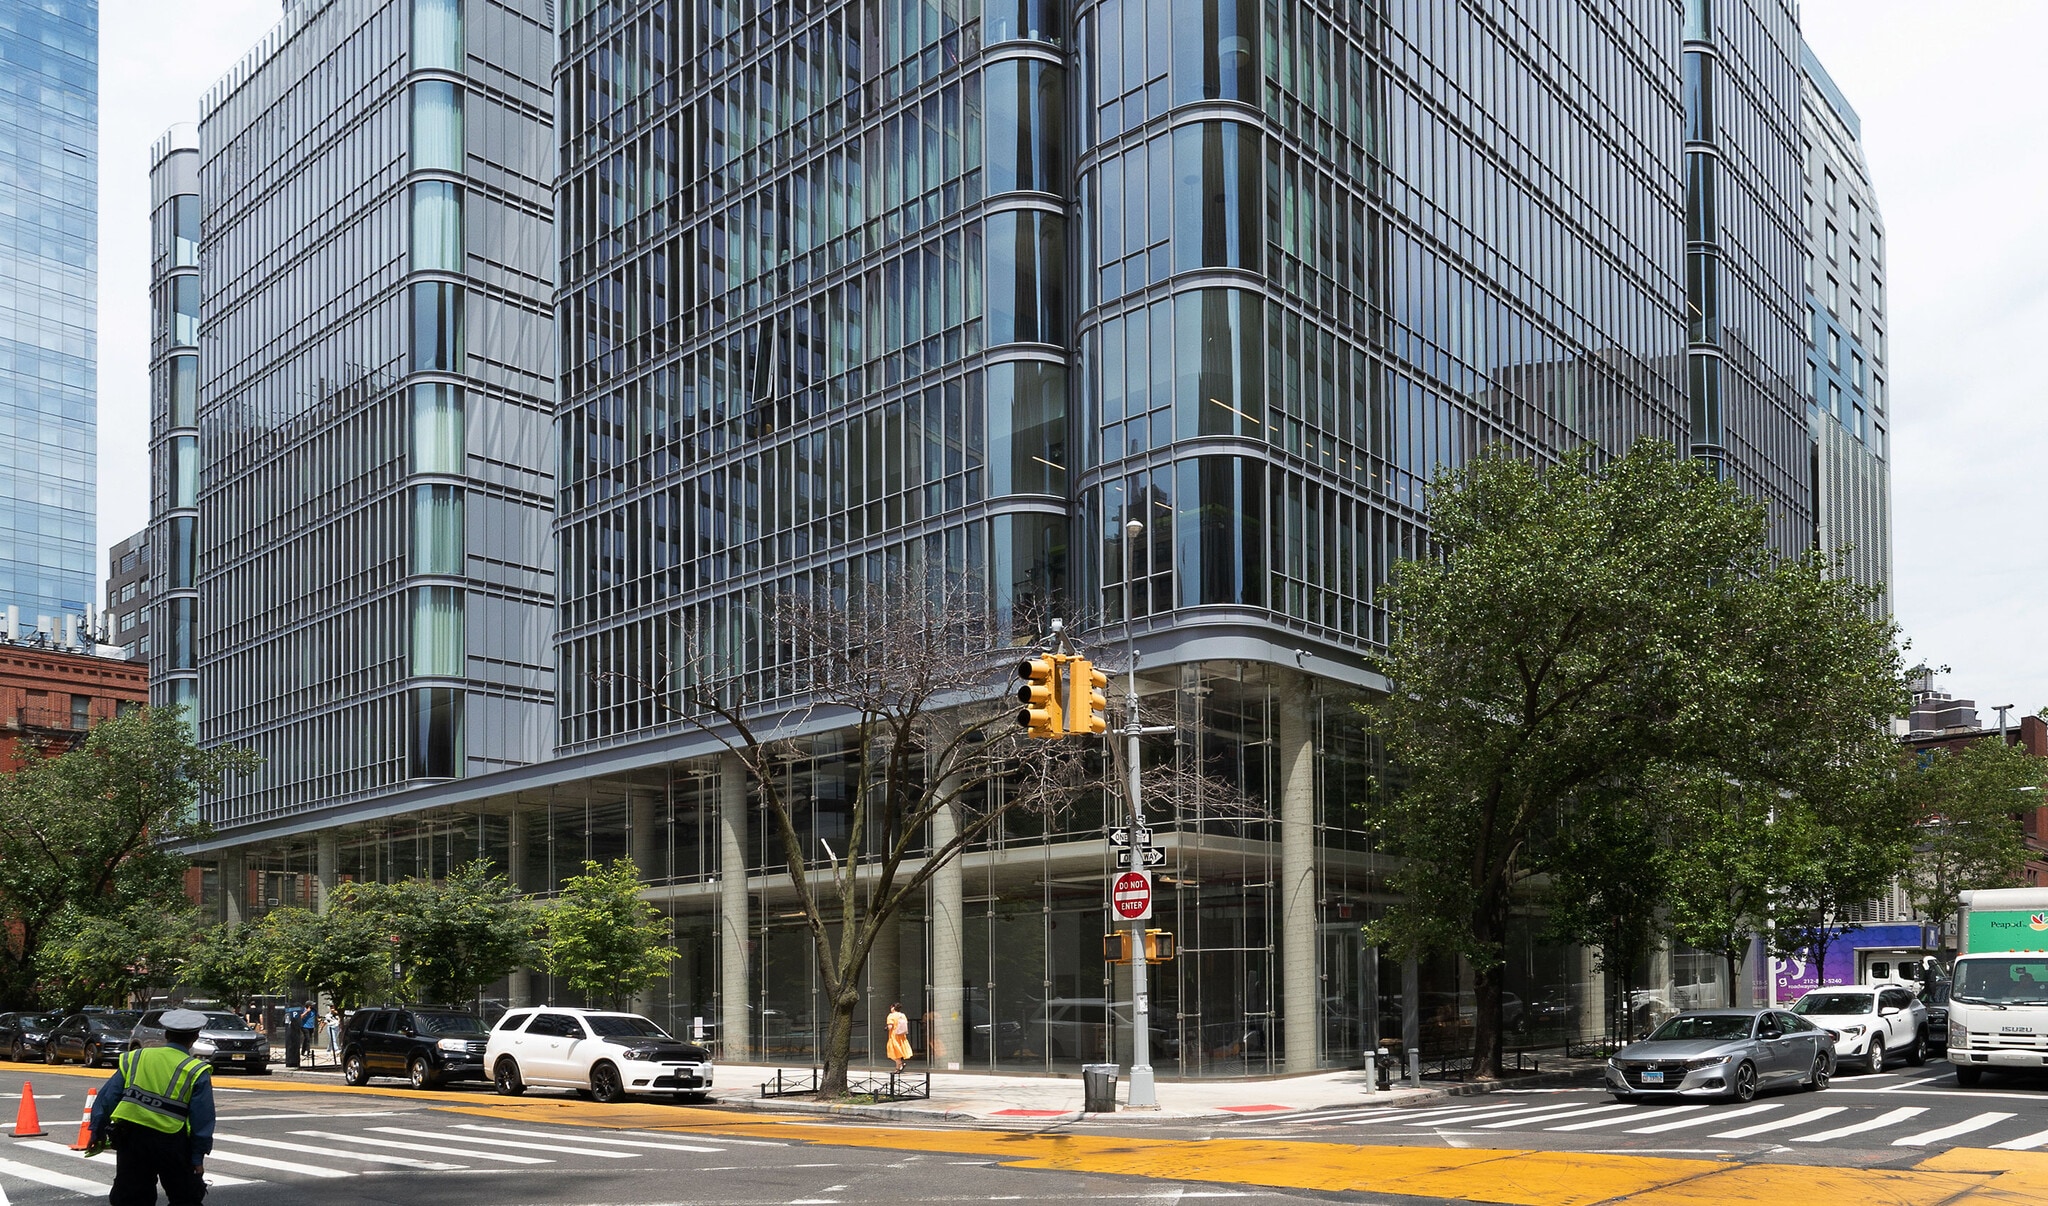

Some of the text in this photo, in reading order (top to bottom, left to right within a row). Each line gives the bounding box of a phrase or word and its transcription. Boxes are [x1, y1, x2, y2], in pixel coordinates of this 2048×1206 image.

[1120, 881, 1143, 890] DO NOT
[1122, 901, 1143, 910] ENTER
[1991, 921, 2022, 929] Peapod
